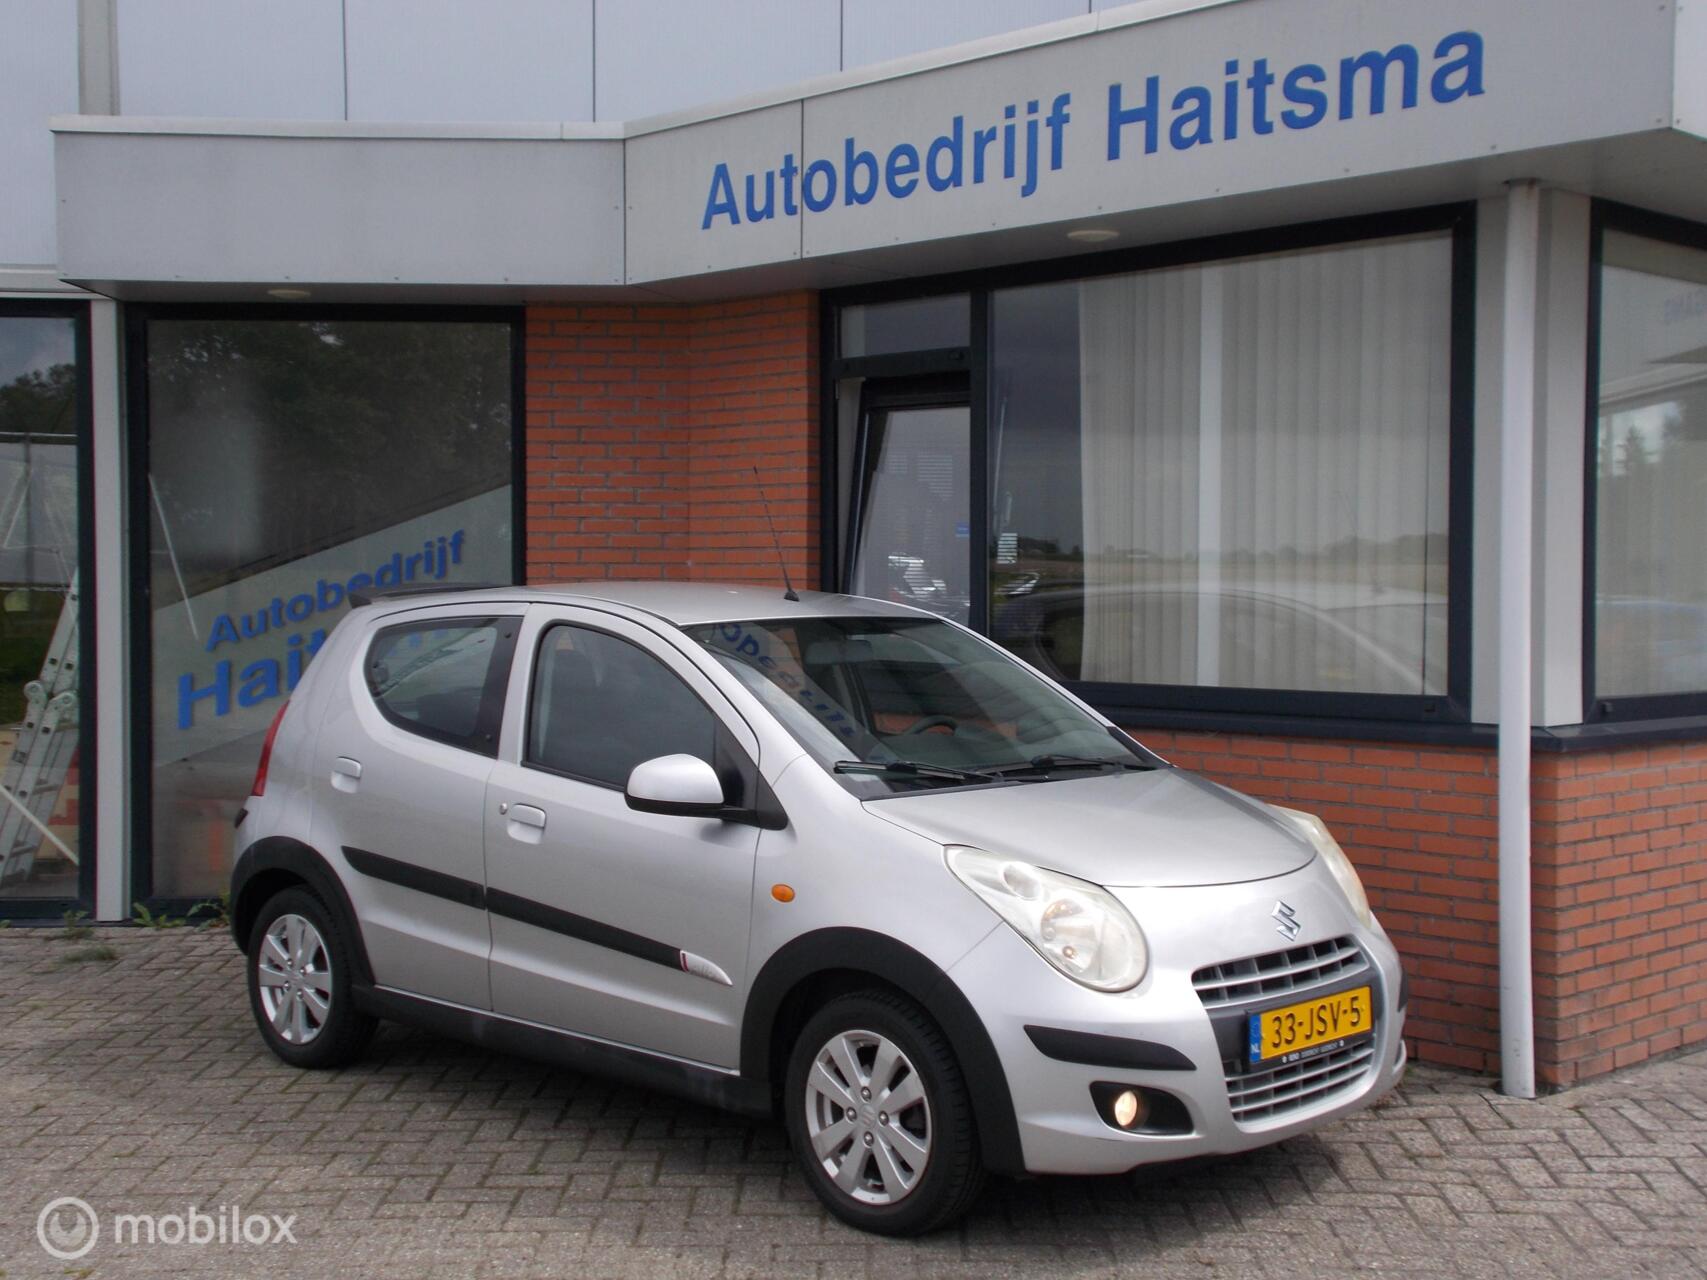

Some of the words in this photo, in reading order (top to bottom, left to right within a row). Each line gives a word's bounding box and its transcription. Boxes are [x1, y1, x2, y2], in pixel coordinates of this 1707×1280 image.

[702, 93, 1073, 230] Autobedrijf
[1107, 30, 1486, 161] Haitsma
[206, 530, 465, 654] Autobedrijf
[1271, 995, 1362, 1049] 33-JSV-5
